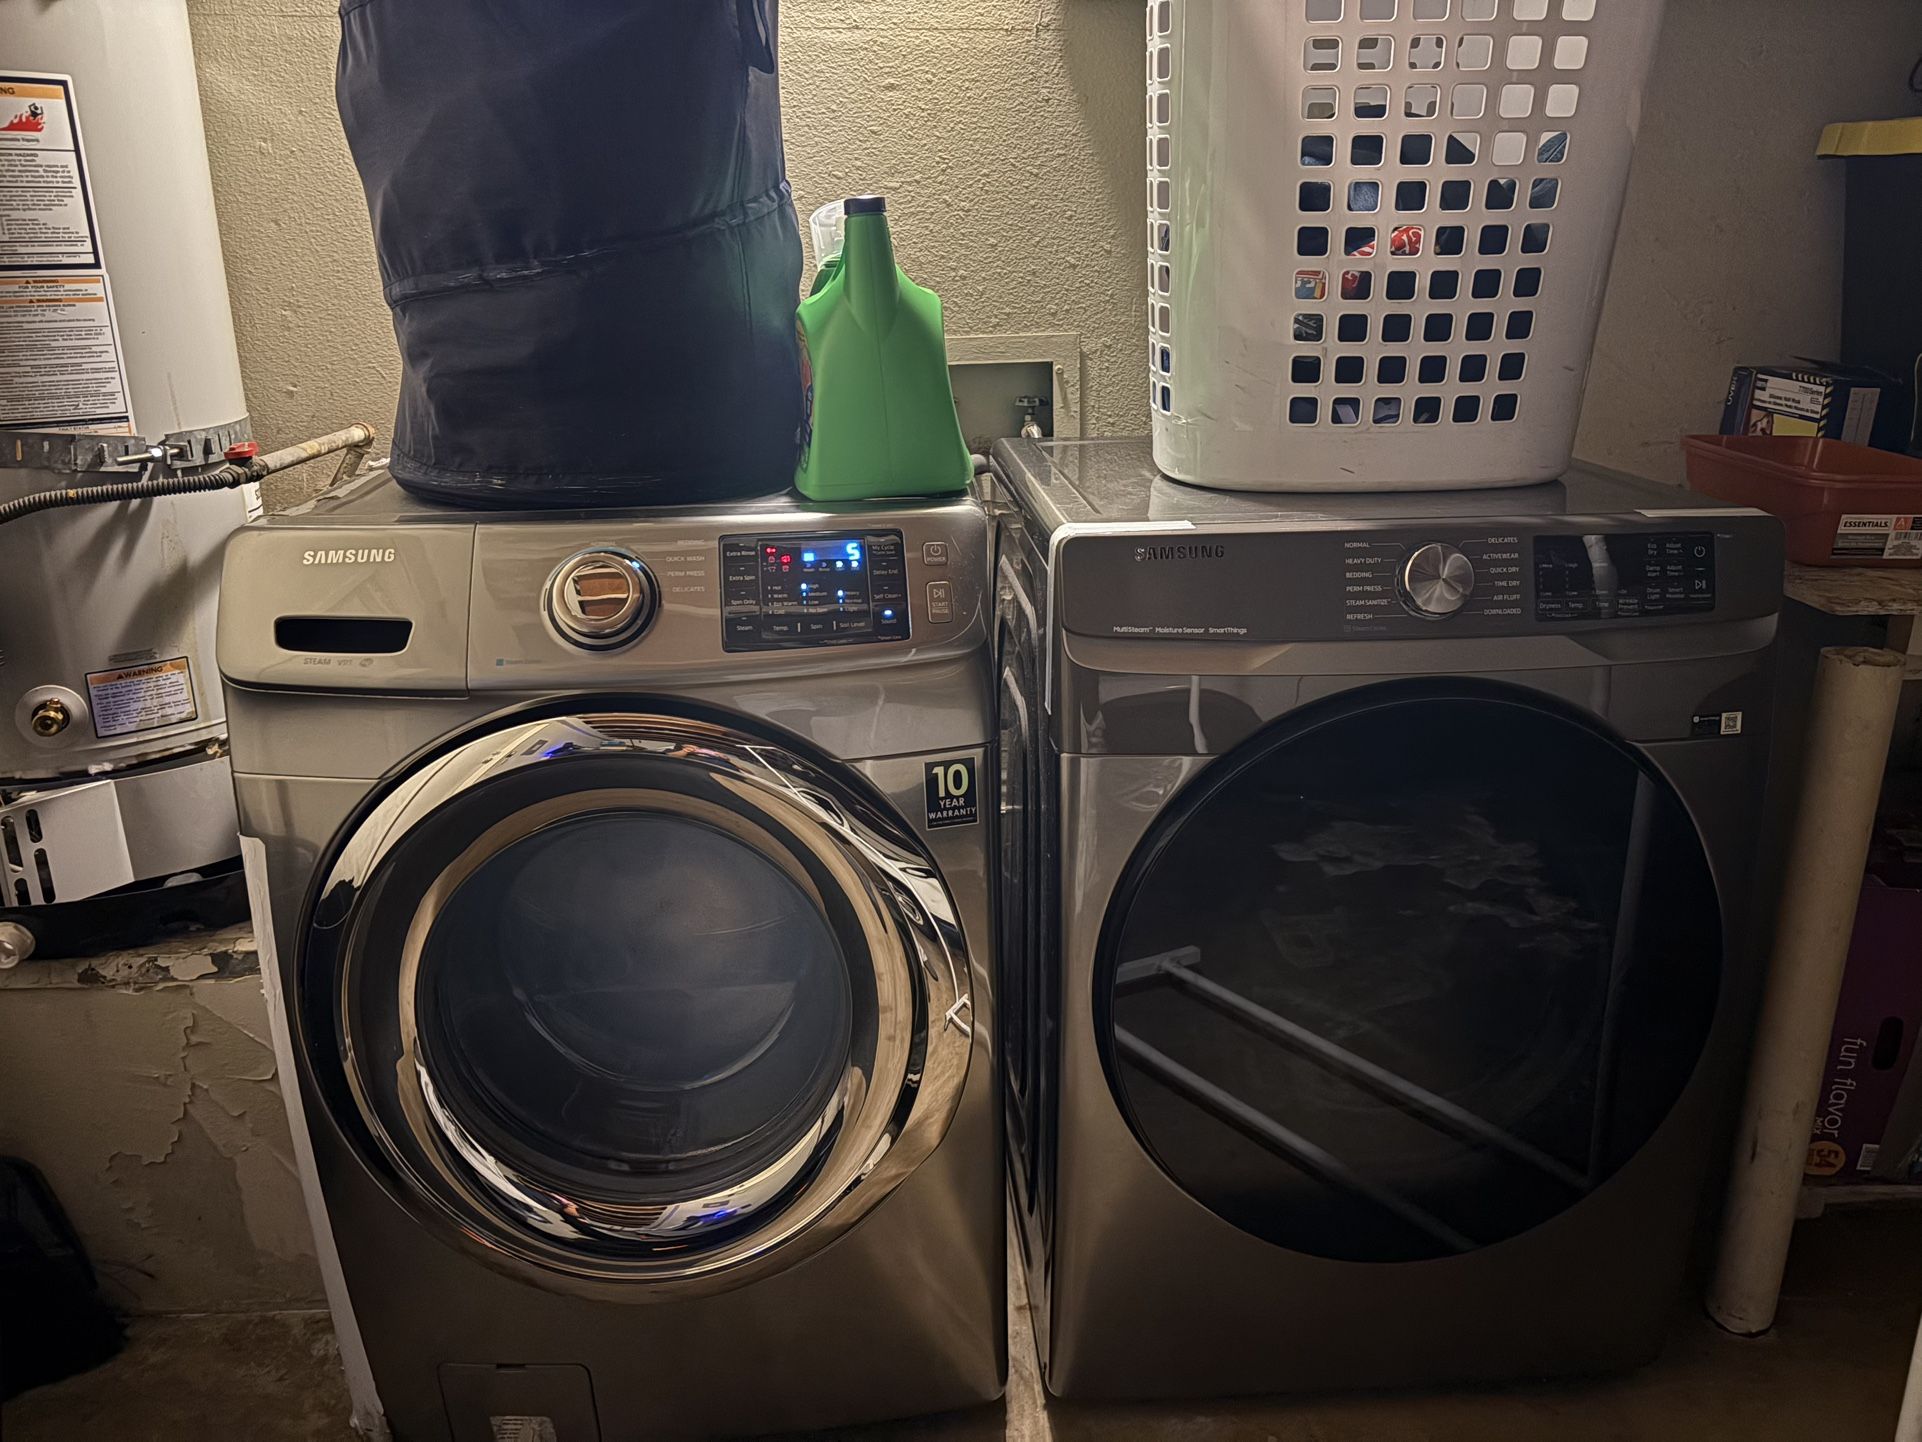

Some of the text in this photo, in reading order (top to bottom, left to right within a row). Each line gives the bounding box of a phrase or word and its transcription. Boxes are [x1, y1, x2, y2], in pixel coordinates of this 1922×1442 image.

[1344, 541, 1371, 549] NORMAL
[302, 548, 396, 566] SAMSUNG
[1135, 545, 1225, 561] SAMSUNG
[1345, 571, 1373, 579] BEDDING
[1363, 584, 1383, 592] PRESS
[1346, 613, 1374, 621] REFRESH
[1483, 608, 1522, 616] DOWNLOADED
[1155, 626, 1183, 634] Moisture
[1208, 627, 1248, 635] SmartThings
[303, 657, 332, 666] STEAM
[123, 665, 164, 679] WARNING
[932, 763, 969, 798] 10
[939, 797, 965, 808] YEAR
[928, 806, 977, 820] WARRANTY
[1824, 1038, 1867, 1138] fun flavor
